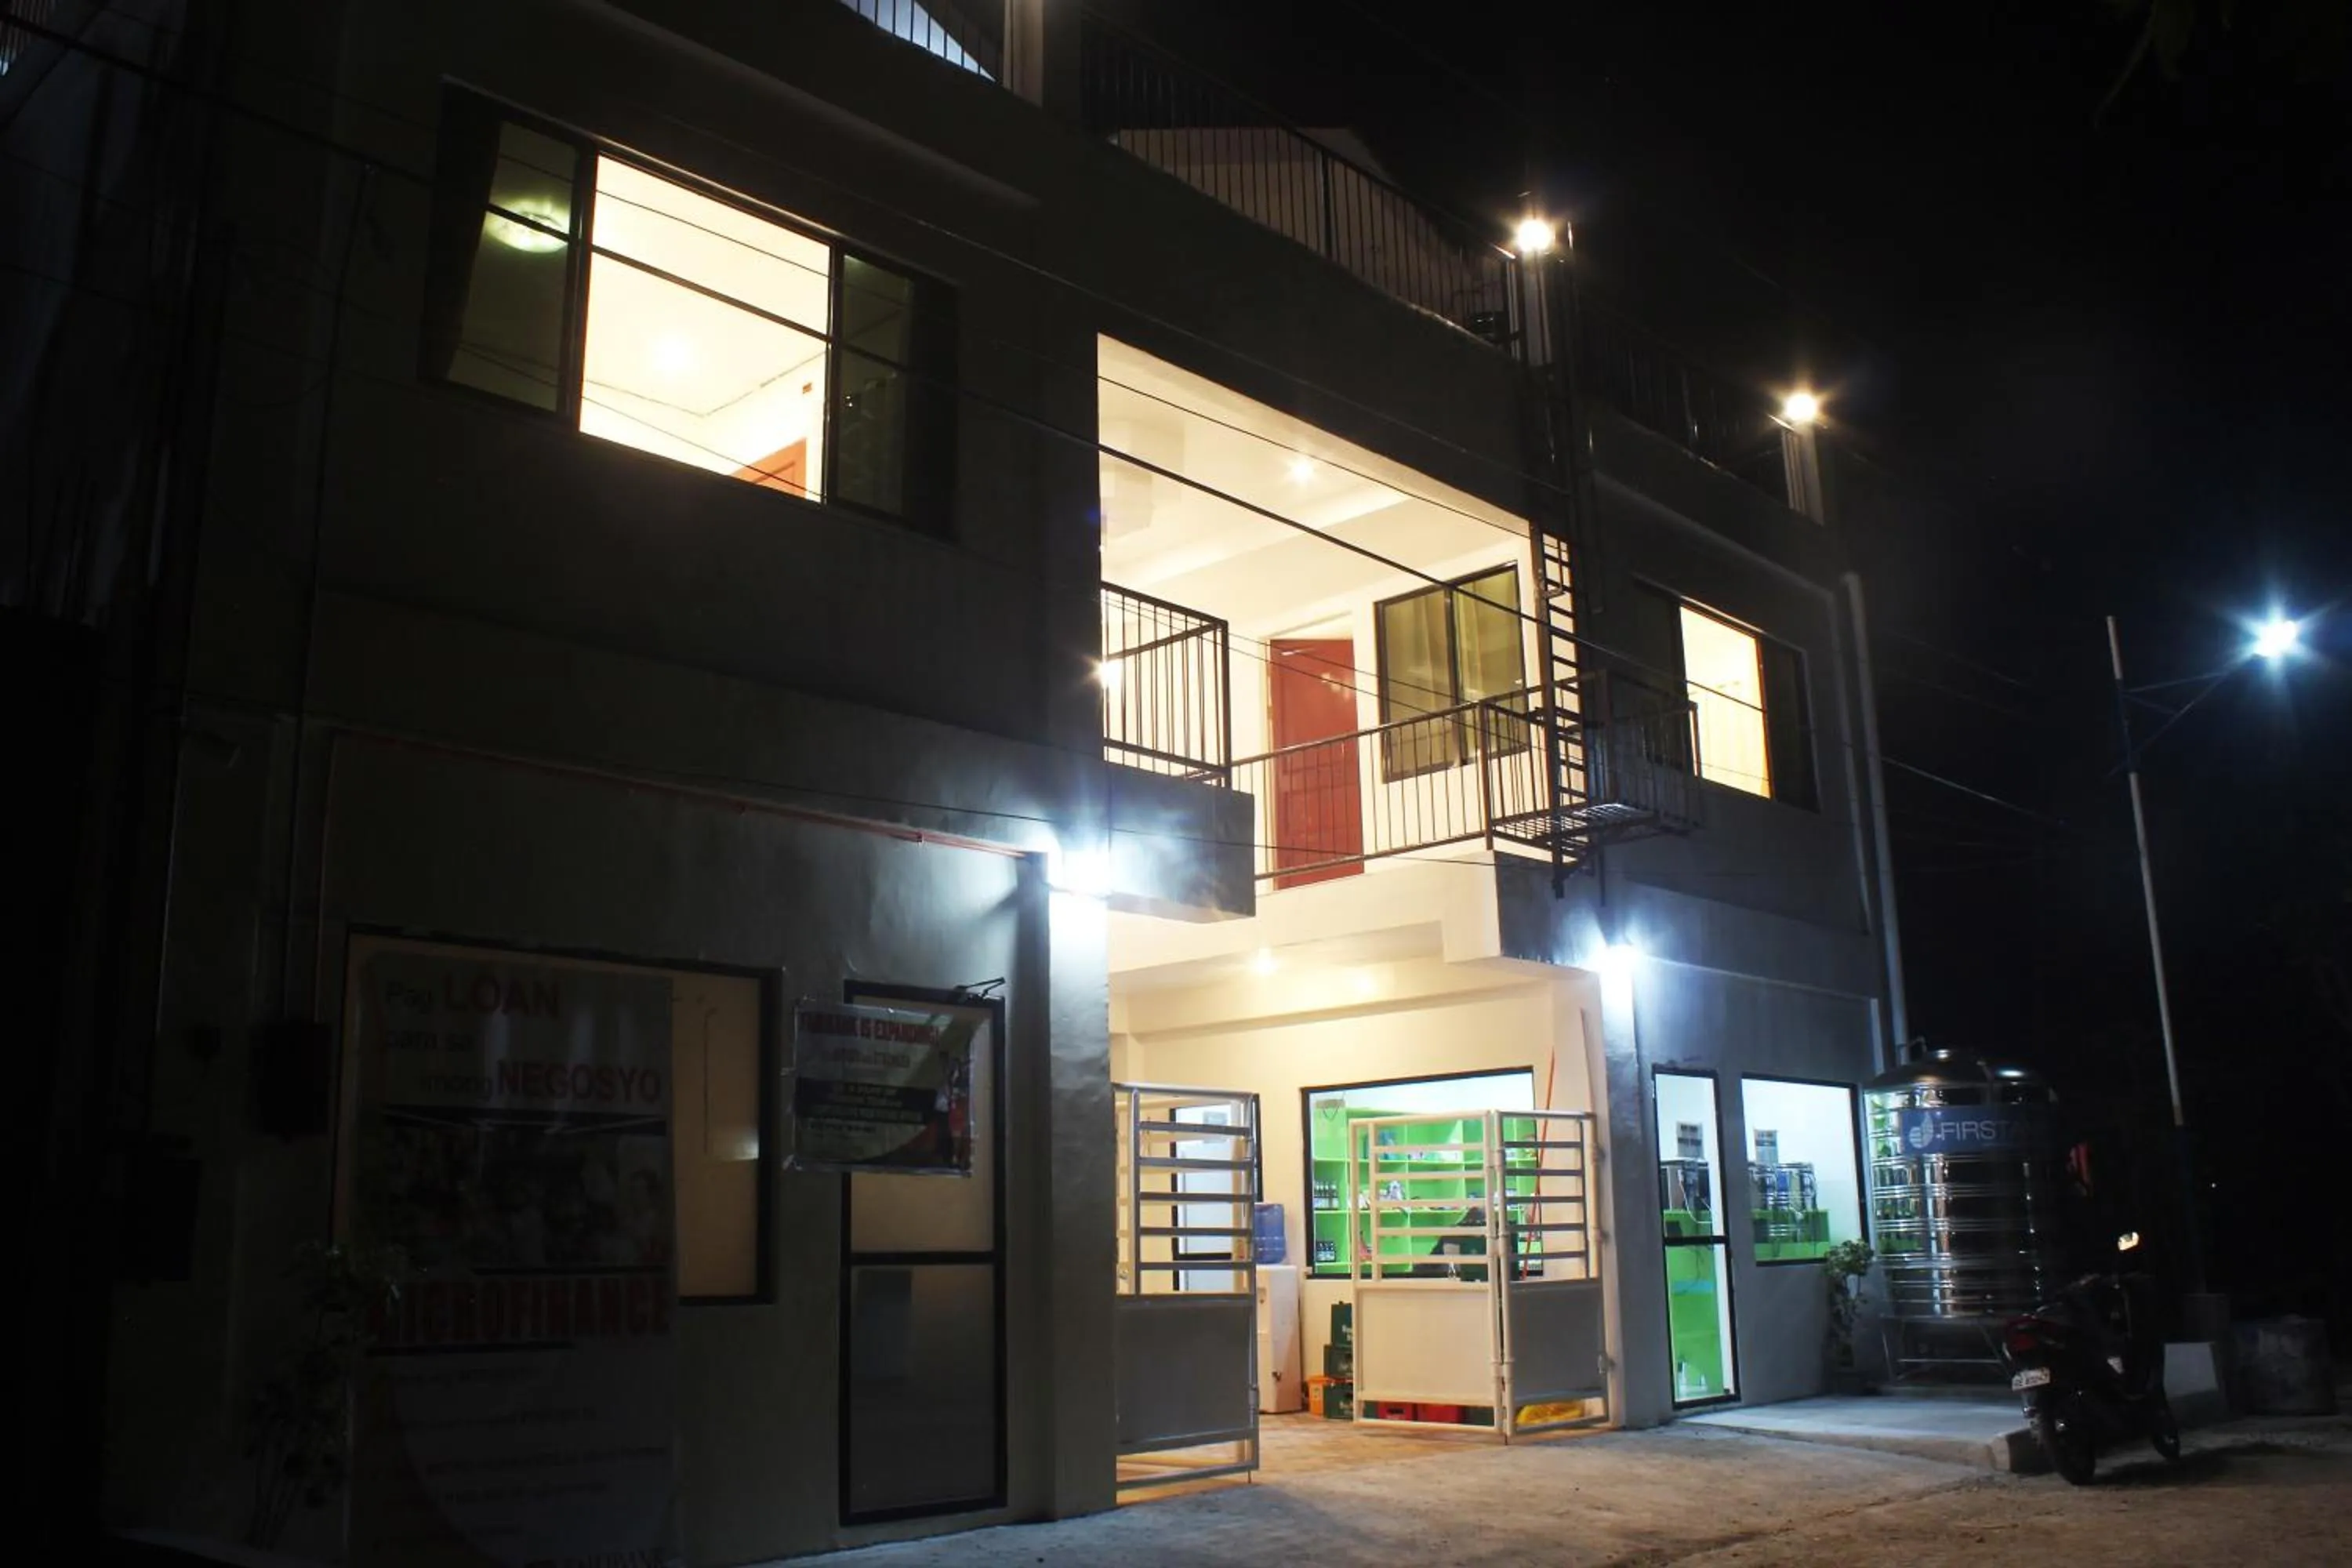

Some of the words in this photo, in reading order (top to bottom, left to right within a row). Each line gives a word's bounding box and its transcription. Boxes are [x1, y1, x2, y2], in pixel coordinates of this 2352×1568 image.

[386, 981, 432, 1014] Pag
[444, 973, 560, 1018] LOAN
[497, 1060, 662, 1105] NEGOSYO
